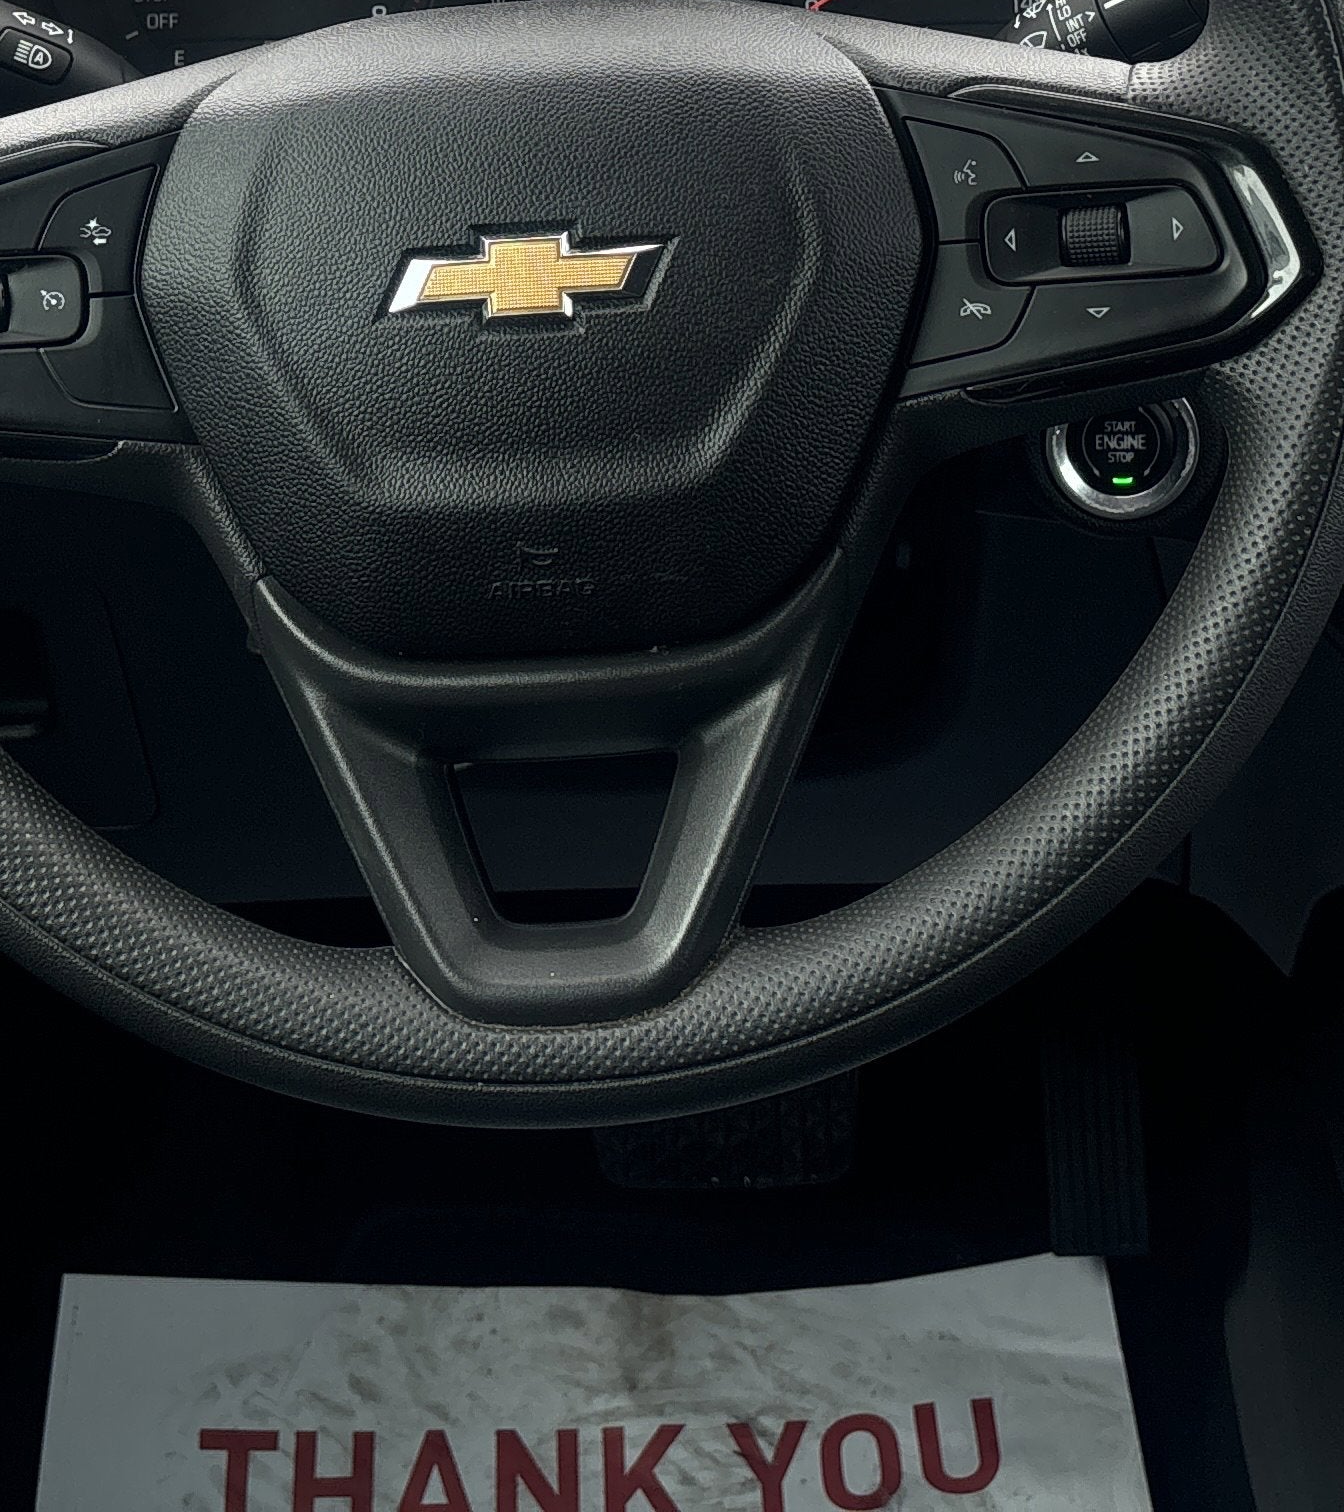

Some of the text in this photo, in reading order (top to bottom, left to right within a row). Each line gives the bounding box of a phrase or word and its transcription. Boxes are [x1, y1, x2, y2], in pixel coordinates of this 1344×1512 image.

[146, 12, 179, 30] OFF
[1056, 4, 1072, 21] LO
[1065, 13, 1085, 33] INT
[1066, 27, 1087, 48] OFF
[174, 49, 185, 66] E
[1104, 420, 1136, 433] START
[1095, 433, 1147, 450] ENGINE
[1107, 451, 1135, 464] STOP
[198, 1396, 1002, 1512] THANK YOU
